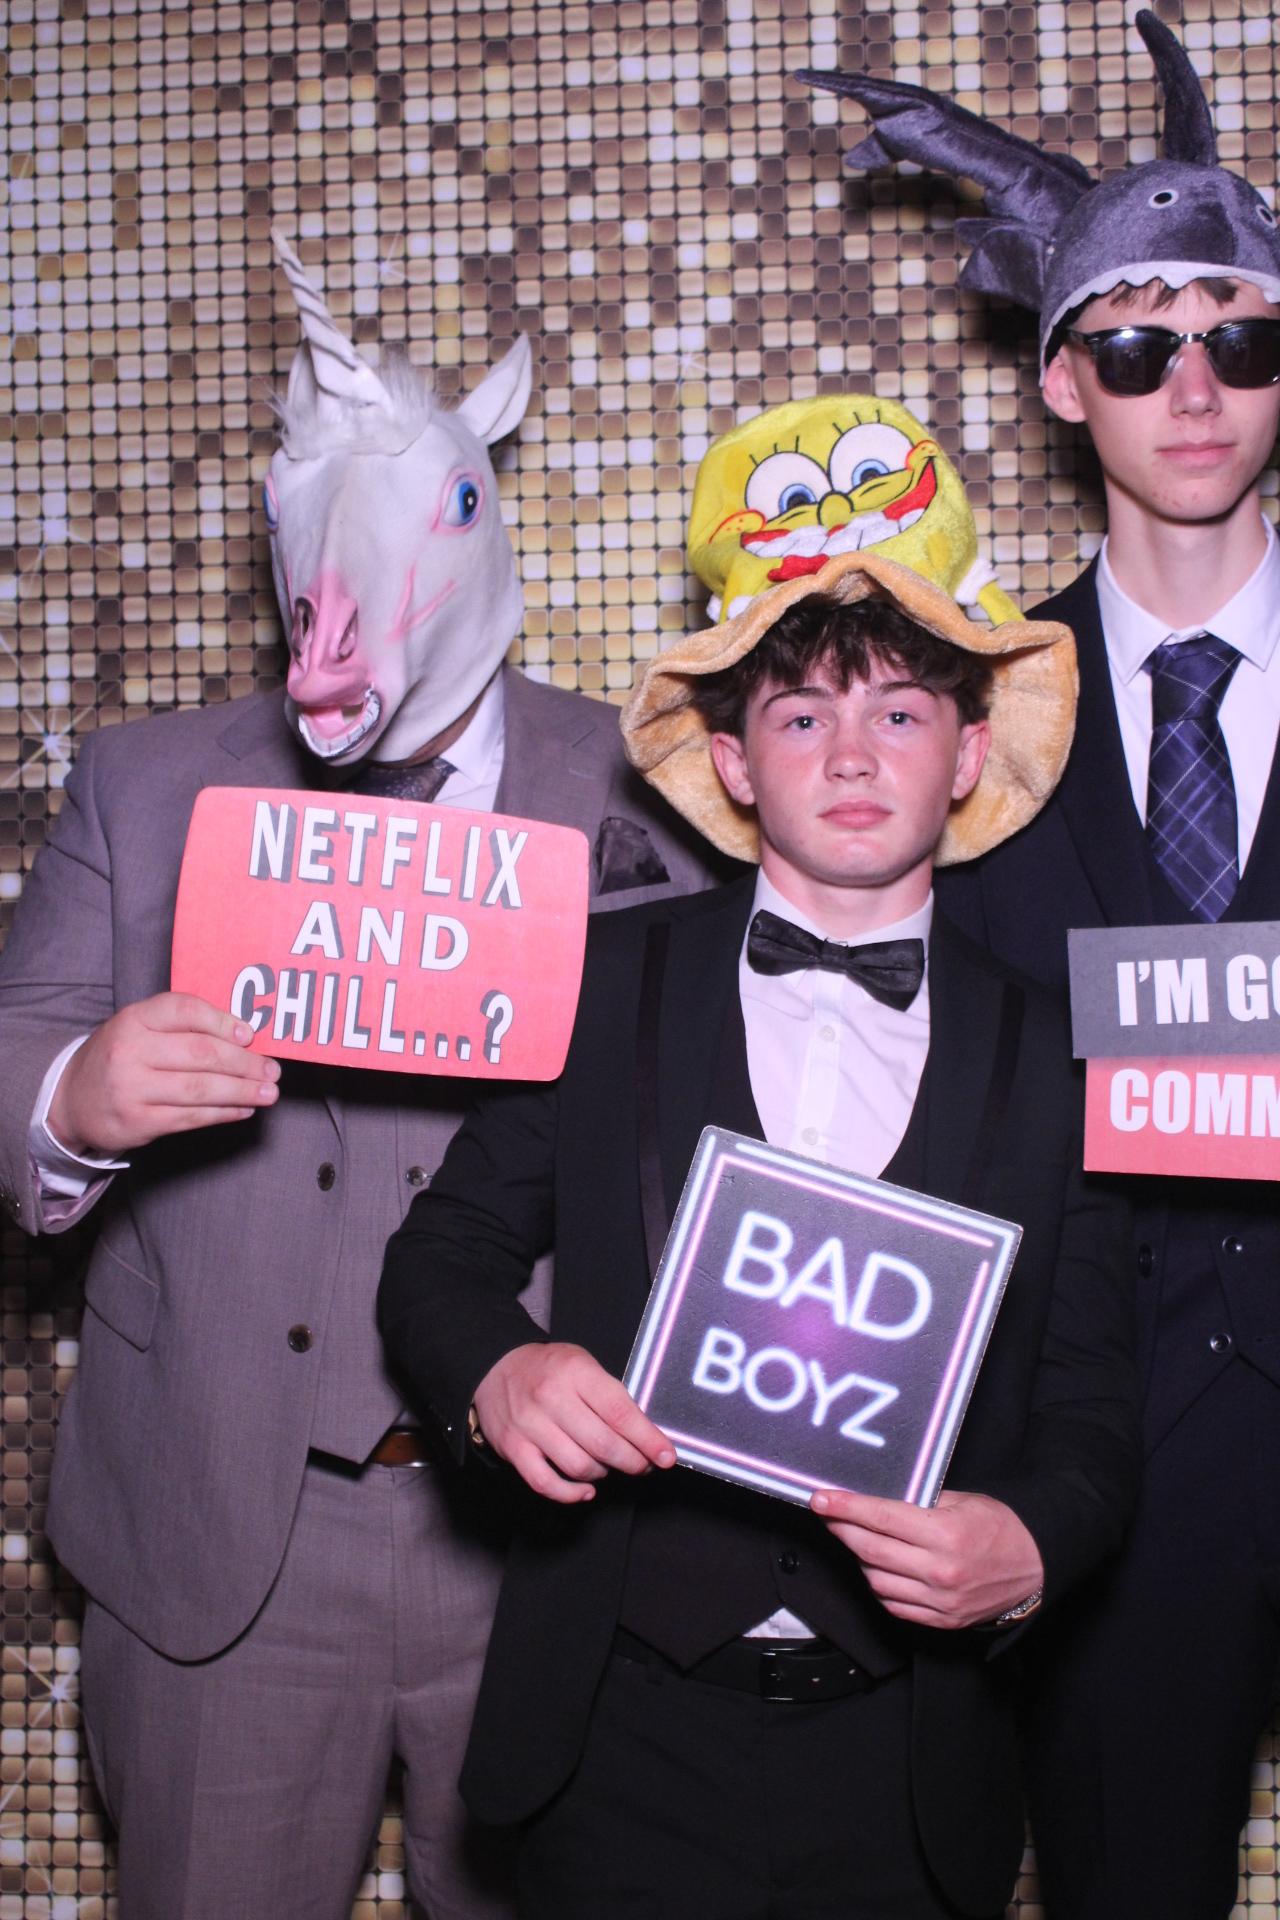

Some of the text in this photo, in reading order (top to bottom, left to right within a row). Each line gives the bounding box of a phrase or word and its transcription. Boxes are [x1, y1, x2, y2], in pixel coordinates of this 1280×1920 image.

[248, 801, 530, 909] NETFLIX
[290, 901, 470, 971] AND
[1117, 954, 1280, 1026] I'M G
[723, 1210, 933, 1341] BAD
[692, 1326, 899, 1448] BOYZ
